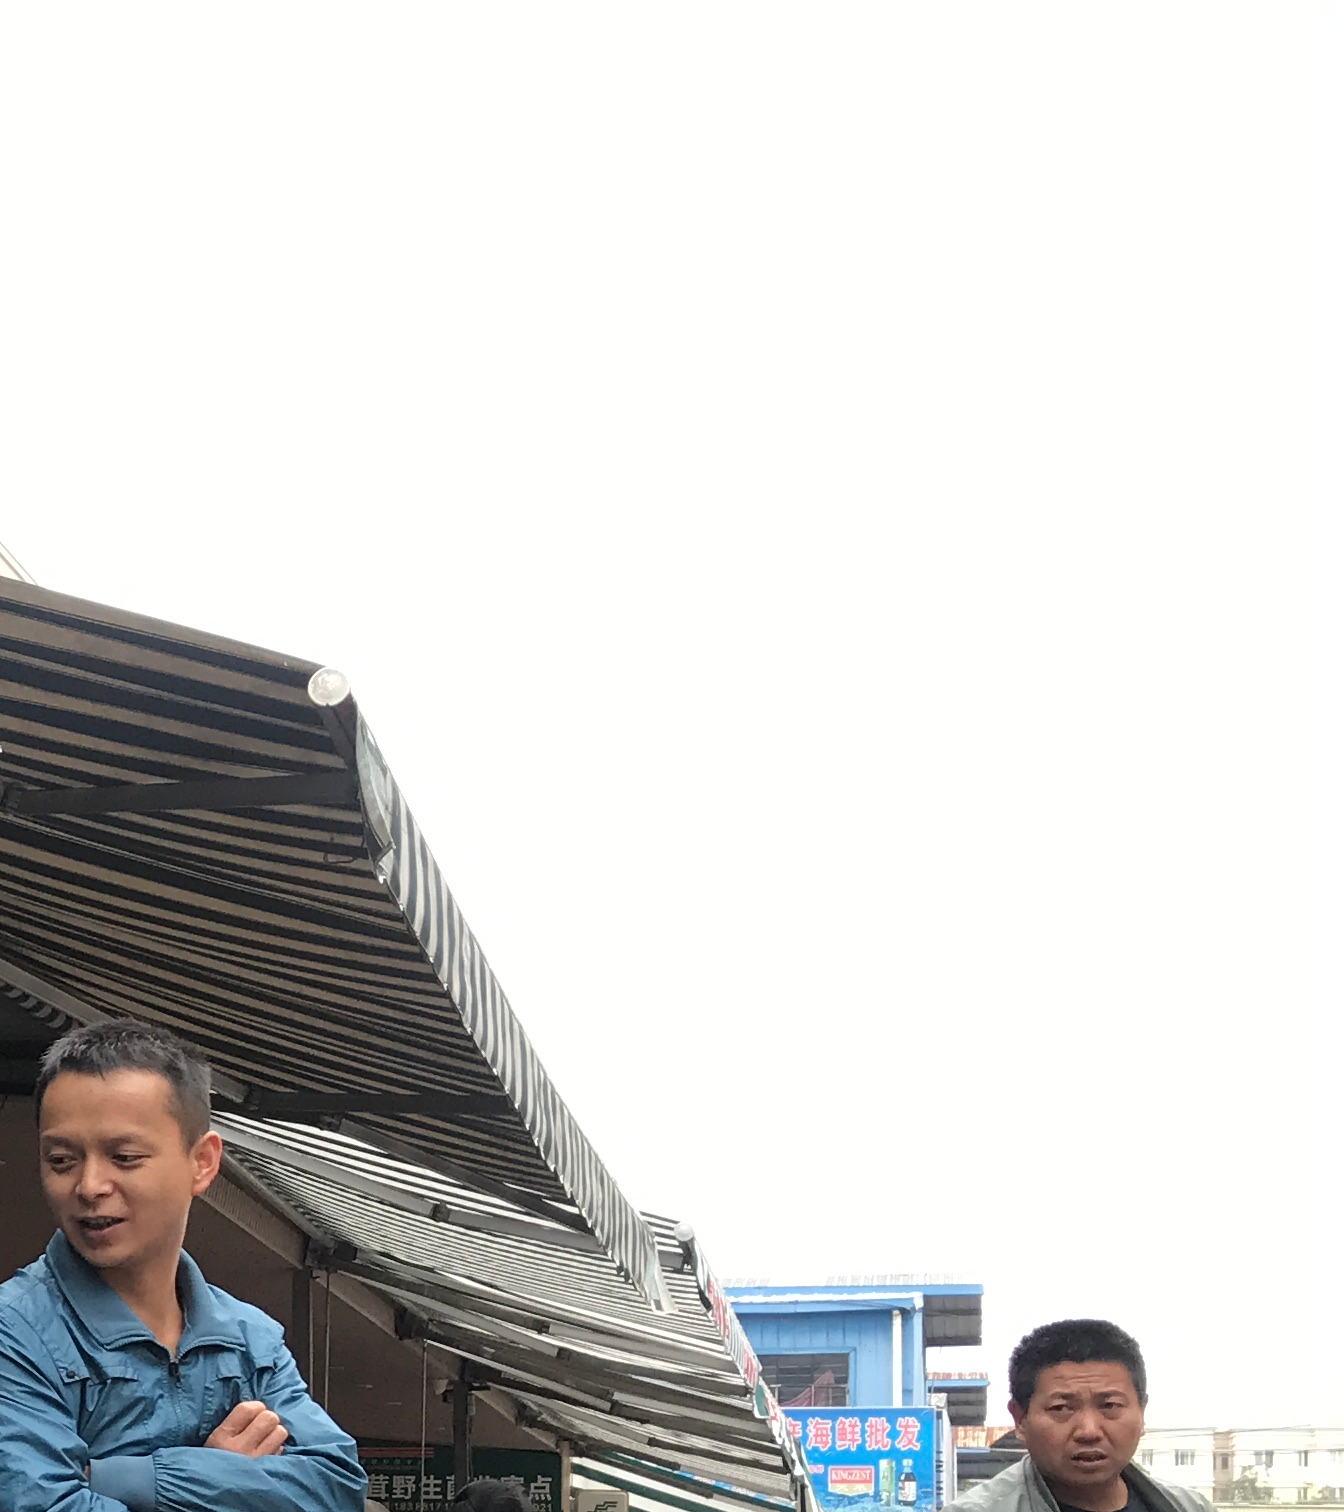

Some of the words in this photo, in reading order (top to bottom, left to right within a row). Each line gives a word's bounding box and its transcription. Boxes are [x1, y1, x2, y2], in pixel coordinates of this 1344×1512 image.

[831, 1469, 872, 1481] KINGZEST
[367, 1473, 554, 1501] 茸野生点
